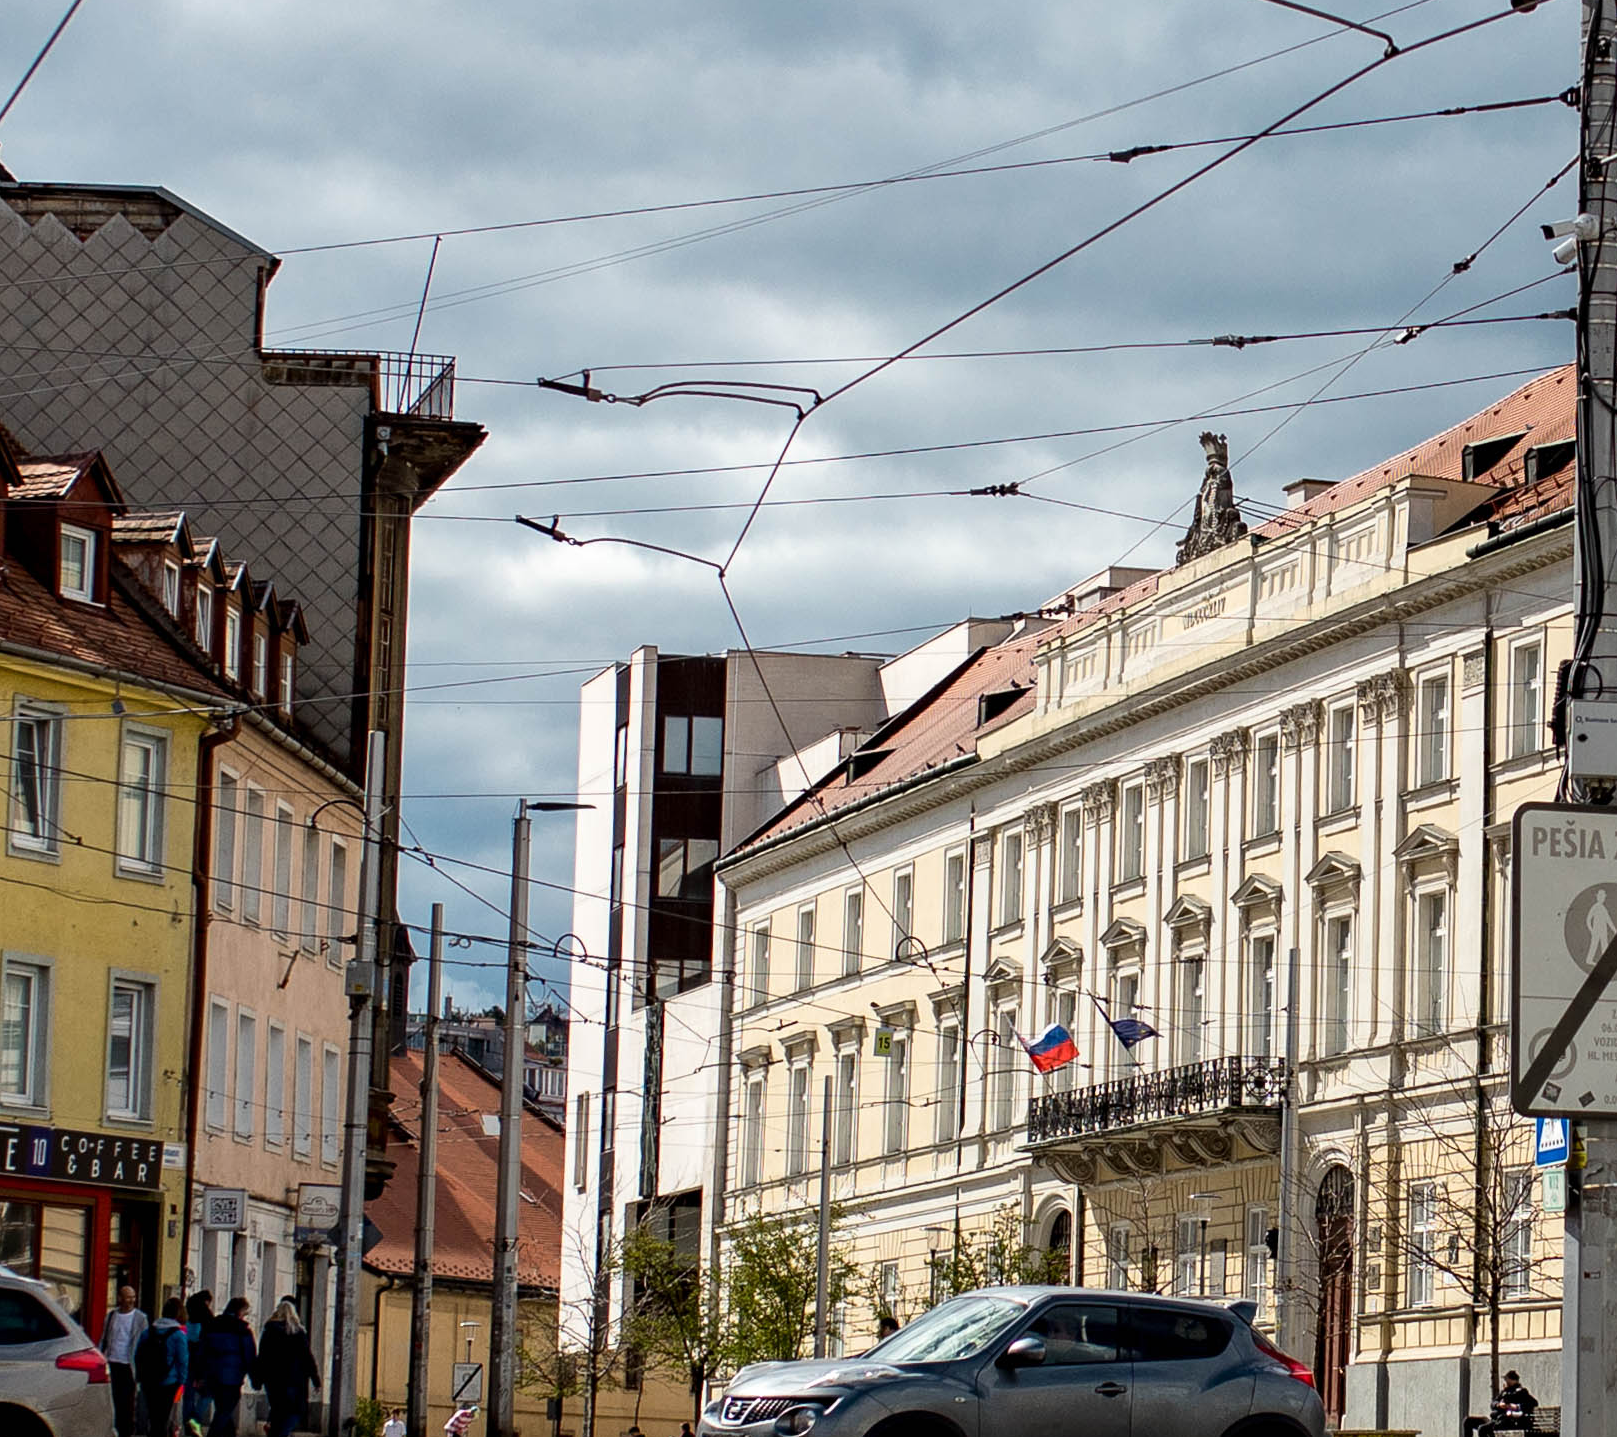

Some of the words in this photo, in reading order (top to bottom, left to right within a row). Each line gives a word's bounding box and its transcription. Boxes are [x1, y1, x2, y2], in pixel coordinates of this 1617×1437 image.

[1532, 819, 1605, 860] PEŠIA
[879, 1036, 890, 1049] 15
[32, 1137, 46, 1166] 10
[68, 1155, 77, 1174] &
[91, 1158, 148, 1183] BAR
